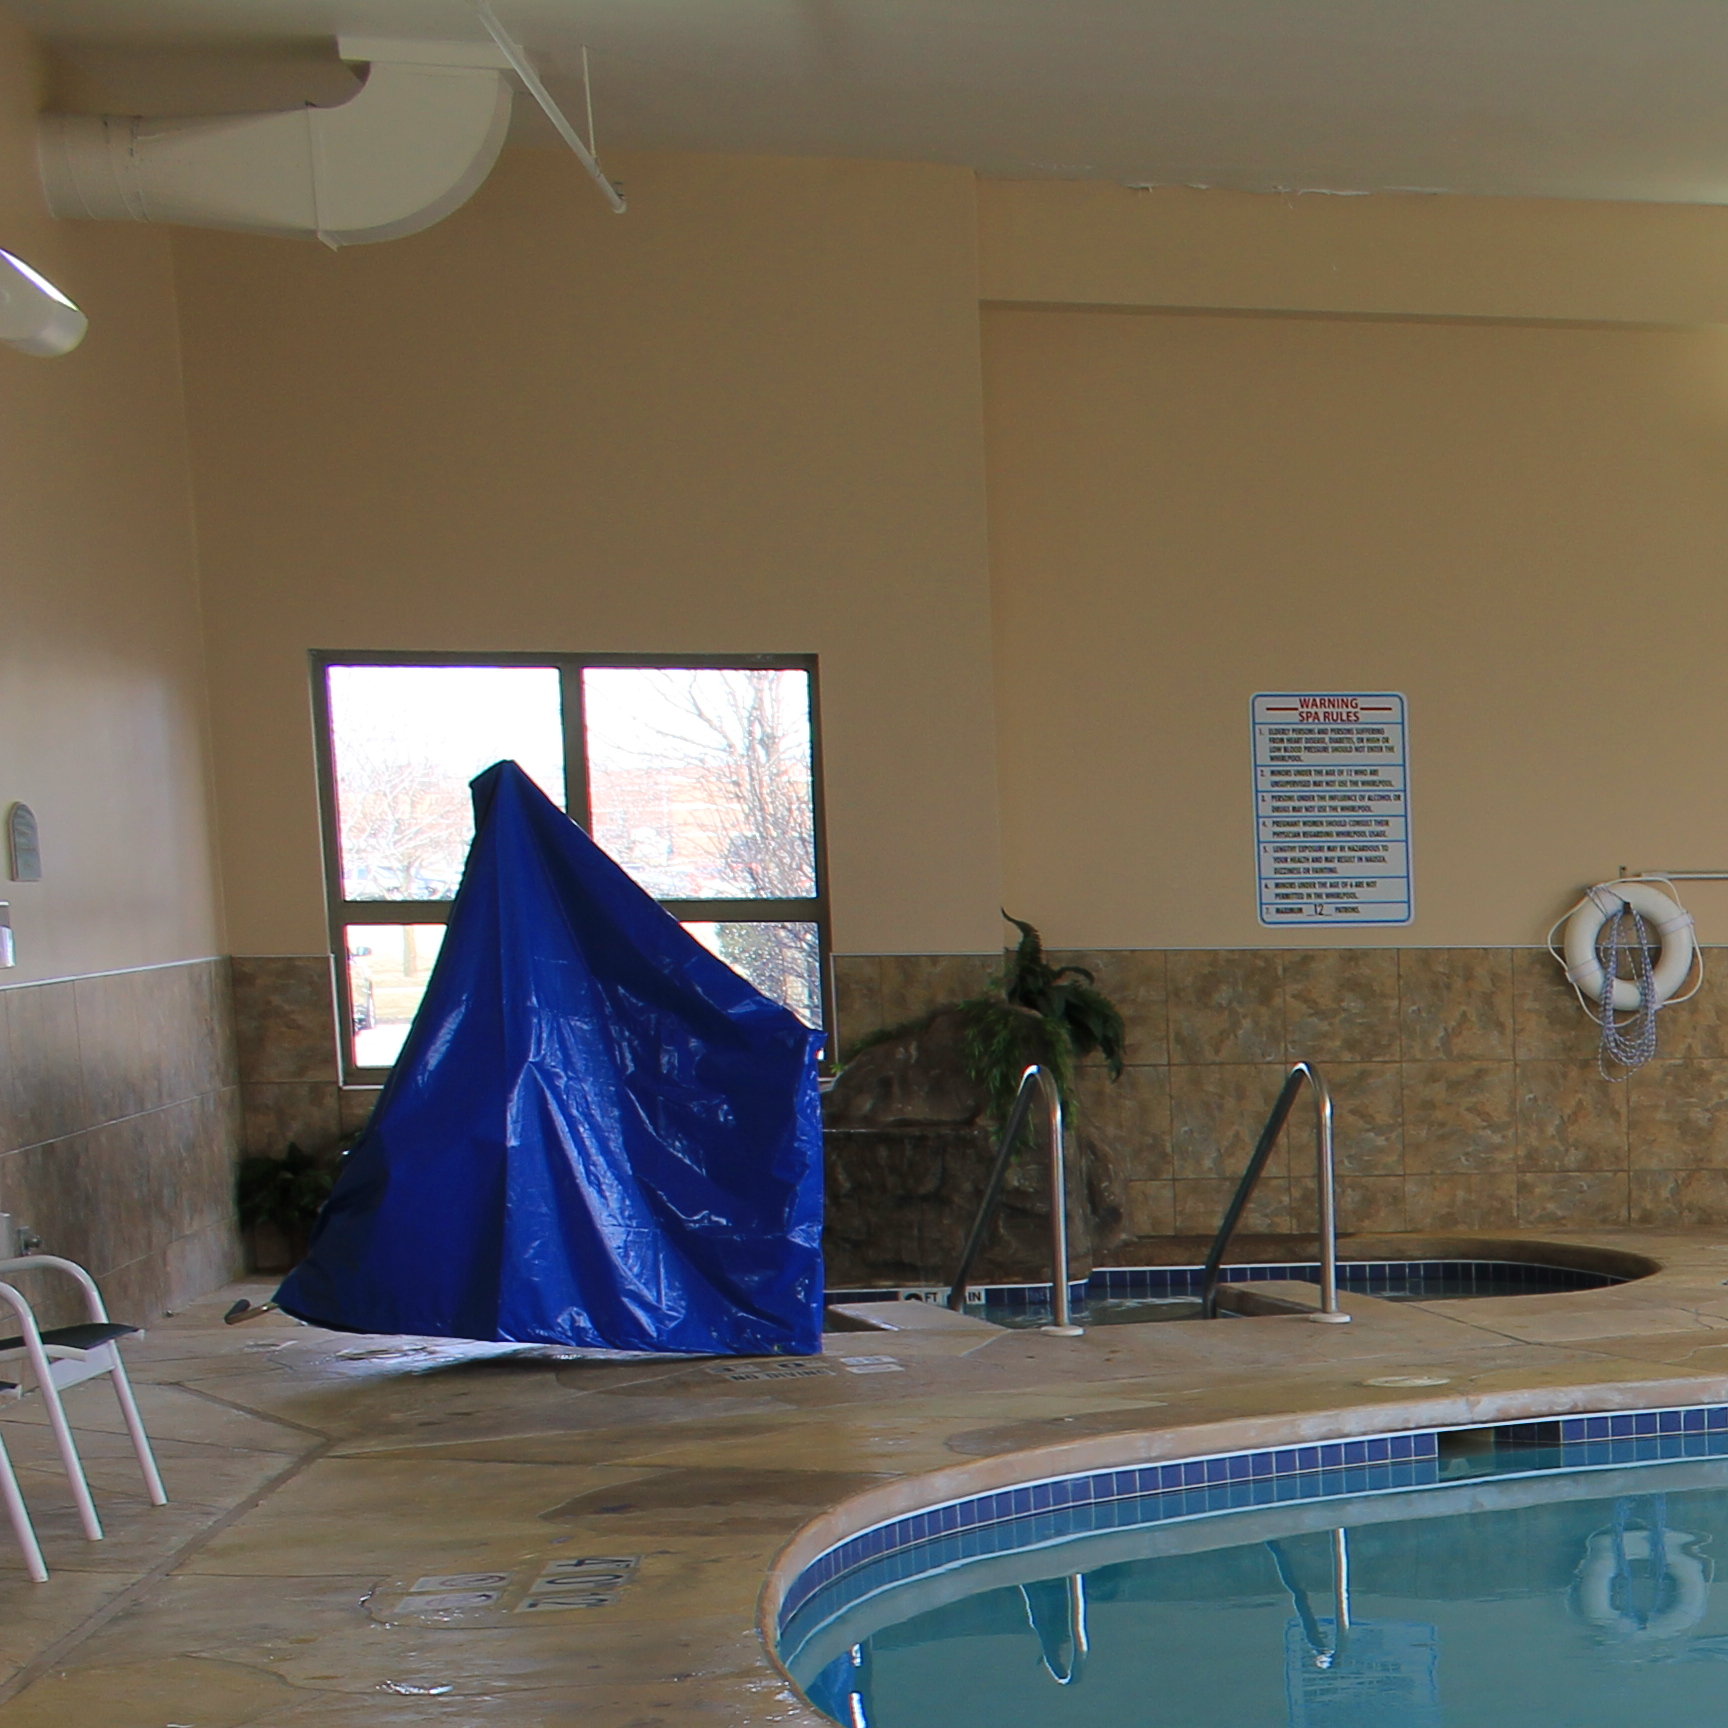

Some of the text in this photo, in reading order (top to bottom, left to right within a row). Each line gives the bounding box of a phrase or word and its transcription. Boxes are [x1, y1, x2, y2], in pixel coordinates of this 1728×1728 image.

[1299, 698, 1358, 709] WARNING
[1299, 711, 1360, 722] SPA RULES
[967, 1292, 981, 1302] IN
